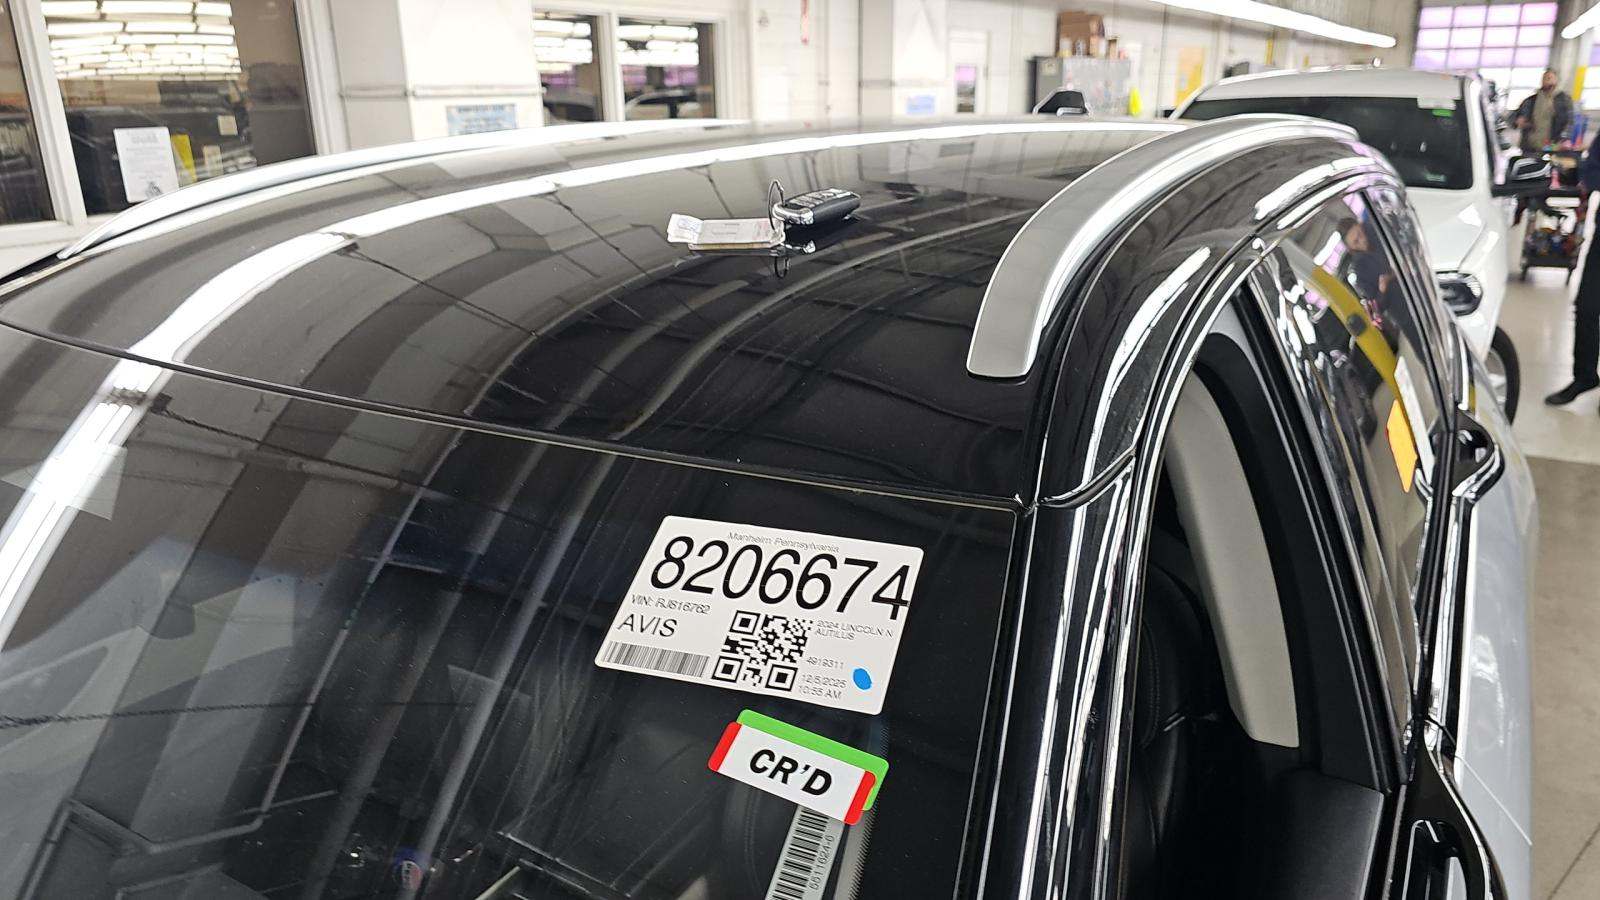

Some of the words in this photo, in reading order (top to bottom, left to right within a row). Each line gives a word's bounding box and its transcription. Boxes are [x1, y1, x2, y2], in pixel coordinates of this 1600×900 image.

[728, 531, 772, 545] Manheim
[773, 537, 840, 552] Pennsylvania
[650, 536, 911, 621] 8206674
[630, 593, 653, 608] VIN:
[616, 613, 678, 638] AVIS
[817, 620, 840, 630] 2024
[841, 622, 883, 637] LINCOLN
[815, 628, 856, 641] AUTILUS
[824, 688, 842, 700] AM
